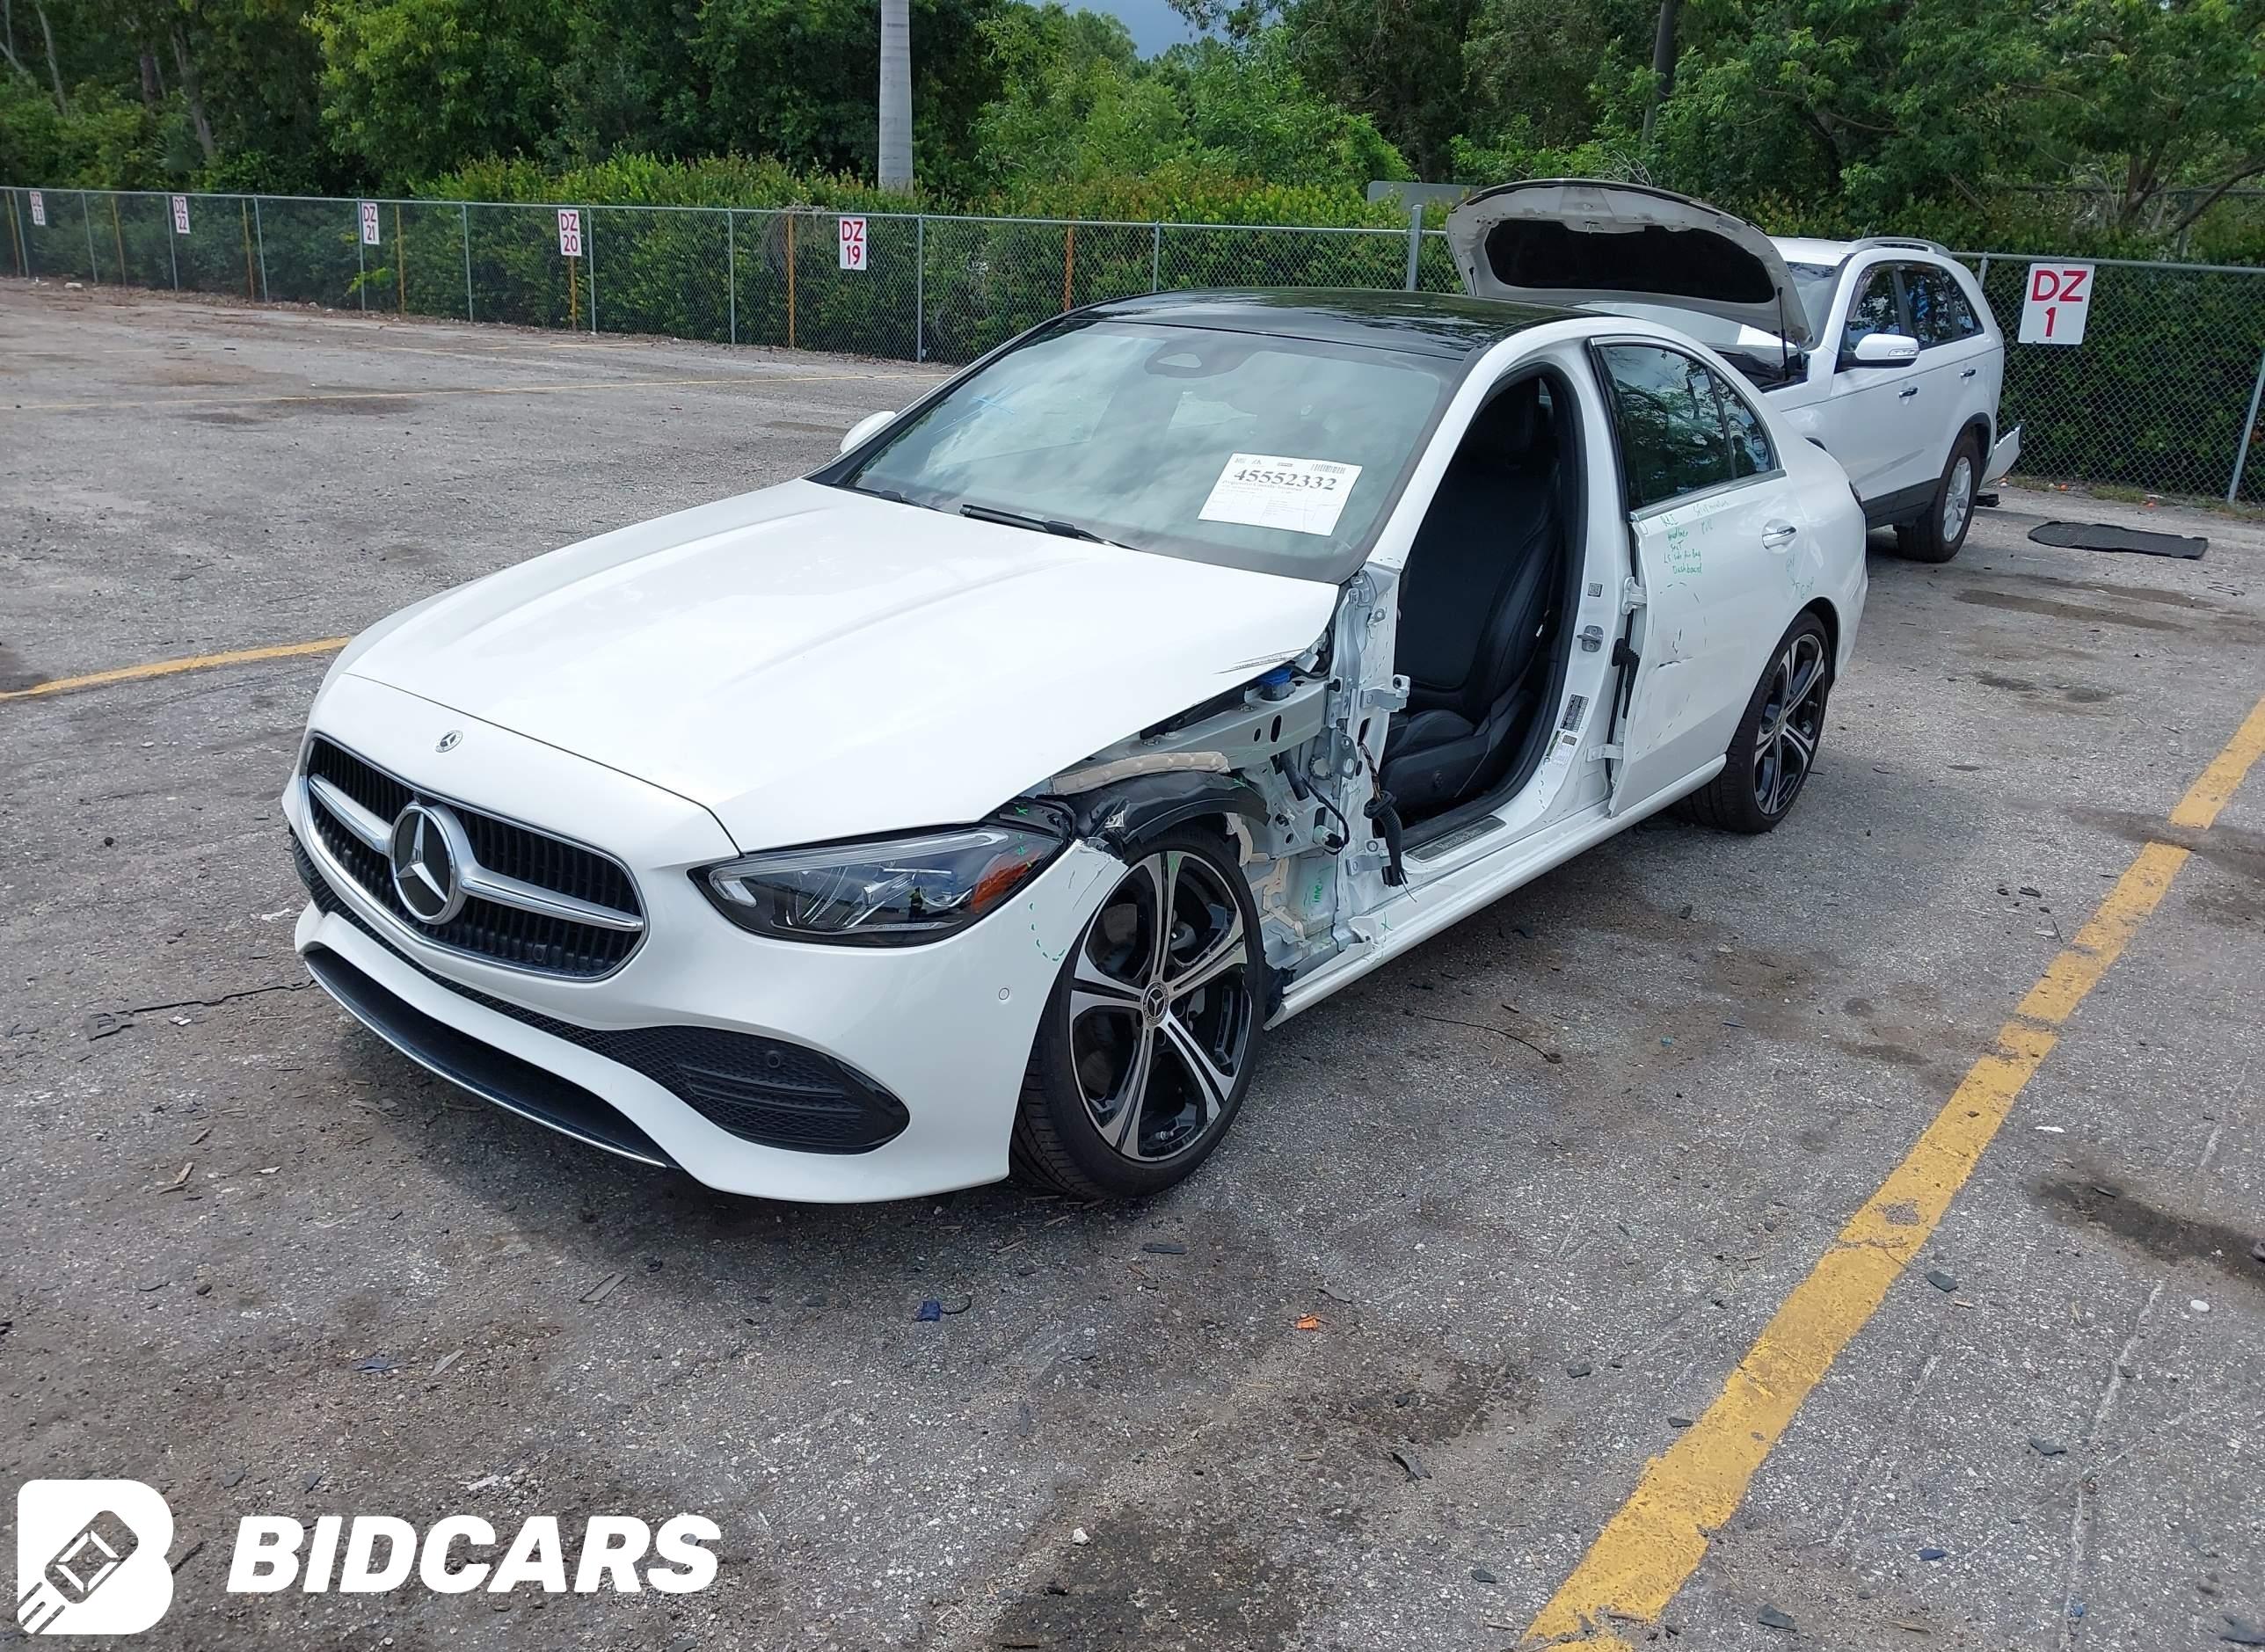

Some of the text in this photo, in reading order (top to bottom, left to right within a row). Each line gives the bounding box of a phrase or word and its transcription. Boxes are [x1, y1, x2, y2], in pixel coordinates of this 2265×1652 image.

[32, 193, 41, 207] DZ
[175, 199, 186, 214] DZ
[178, 215, 187, 229] 22
[363, 205, 376, 222] DZ
[560, 213, 578, 231] DZ
[366, 224, 375, 241] 21
[841, 220, 863, 242] DZ
[563, 234, 578, 252] 20
[846, 244, 861, 266] 19
[2031, 269, 2088, 302] DZ
[2045, 306, 2057, 338] 1
[1234, 469, 1336, 491] 45552332
